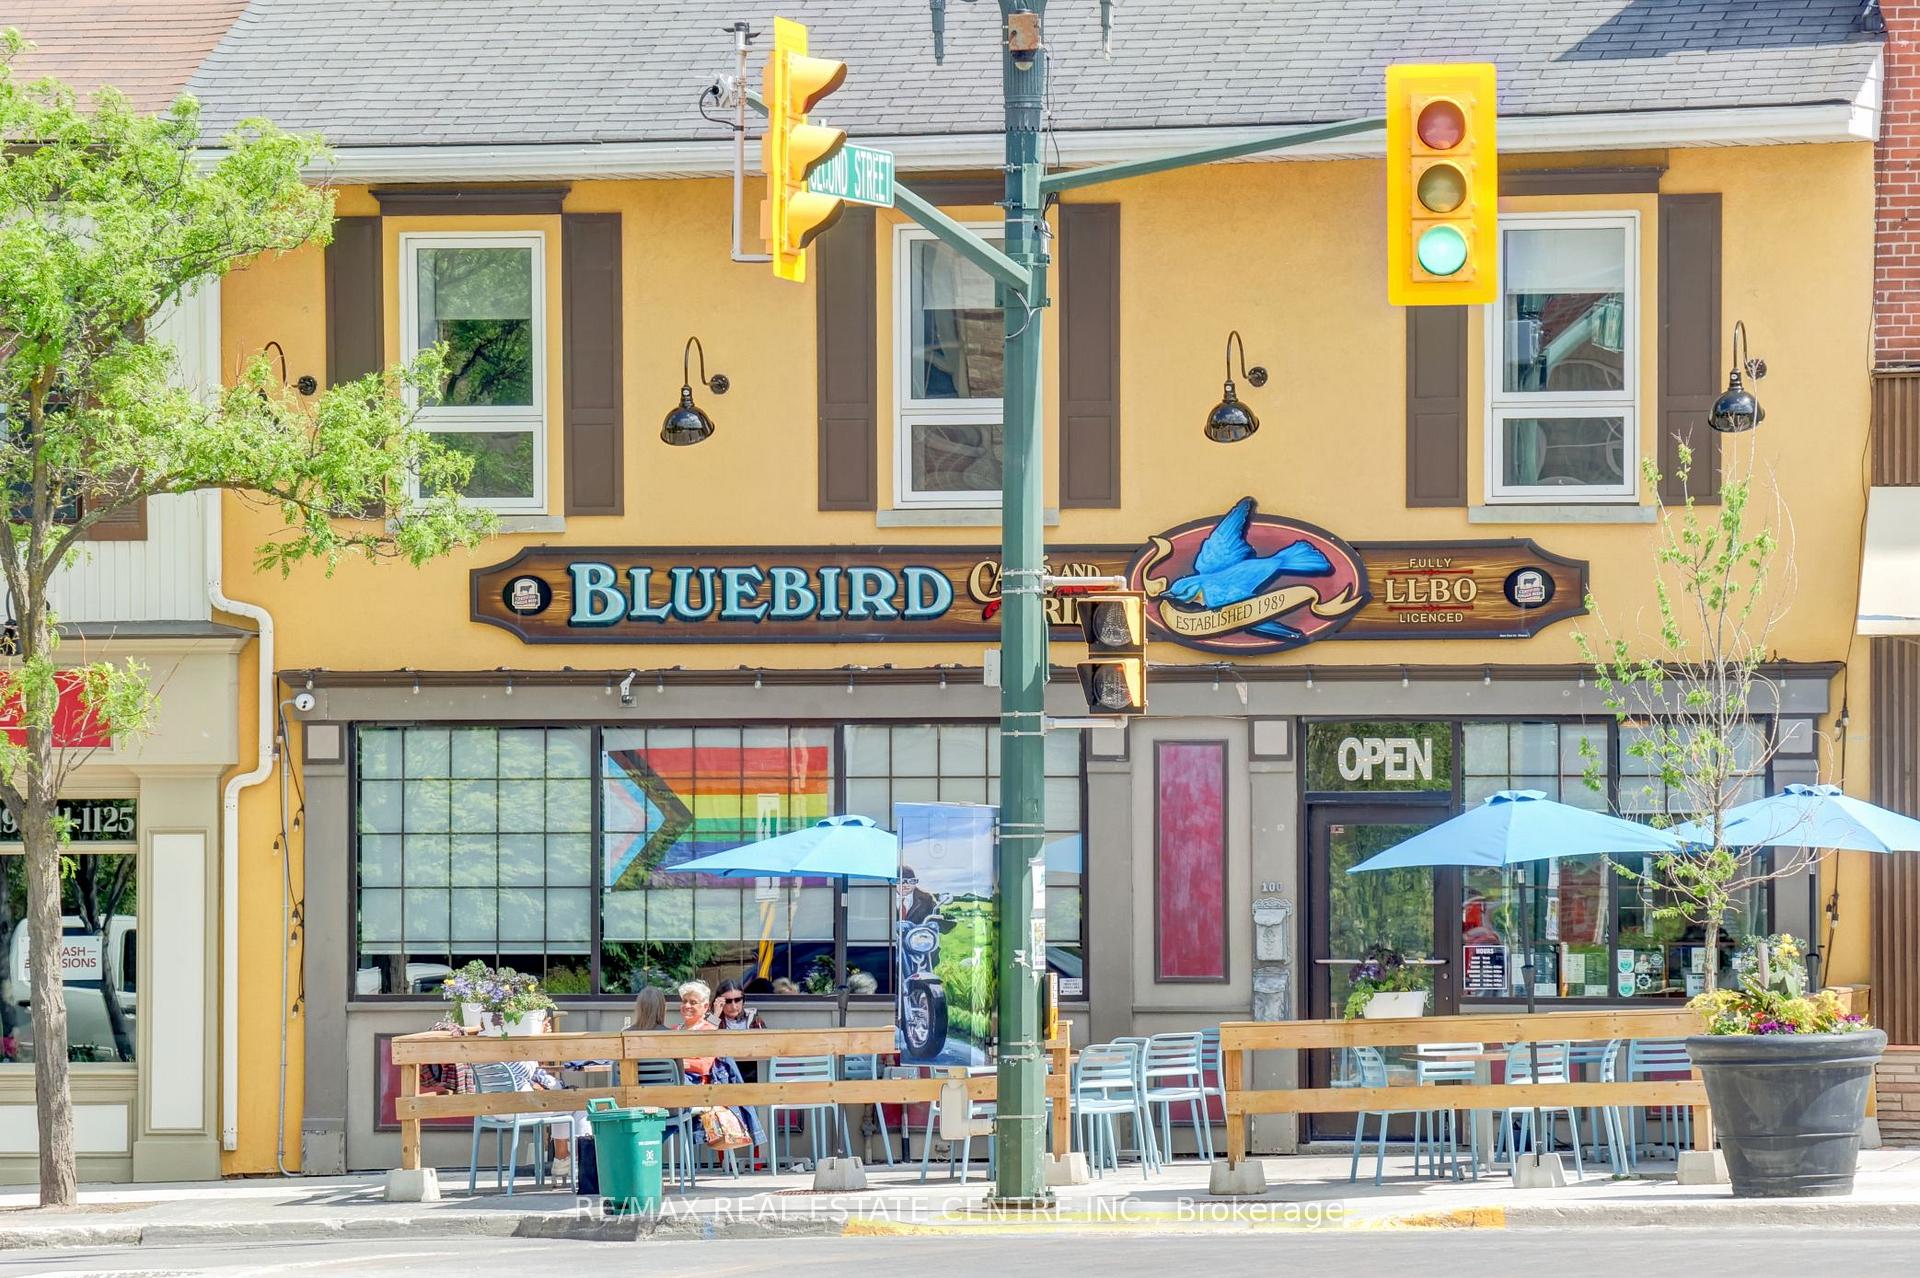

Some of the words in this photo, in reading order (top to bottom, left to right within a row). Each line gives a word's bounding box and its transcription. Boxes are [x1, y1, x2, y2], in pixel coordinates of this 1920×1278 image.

[854, 149, 891, 203] STREET
[1409, 558, 1452, 568] FULLY
[568, 561, 954, 627] BLUEBIRD
[1385, 578, 1477, 603] LLBO
[1176, 603, 1253, 632] ESTABLISHED
[1258, 593, 1286, 615] 1989
[1399, 612, 1464, 623] LICENCED
[1338, 737, 1433, 781] OPEN
